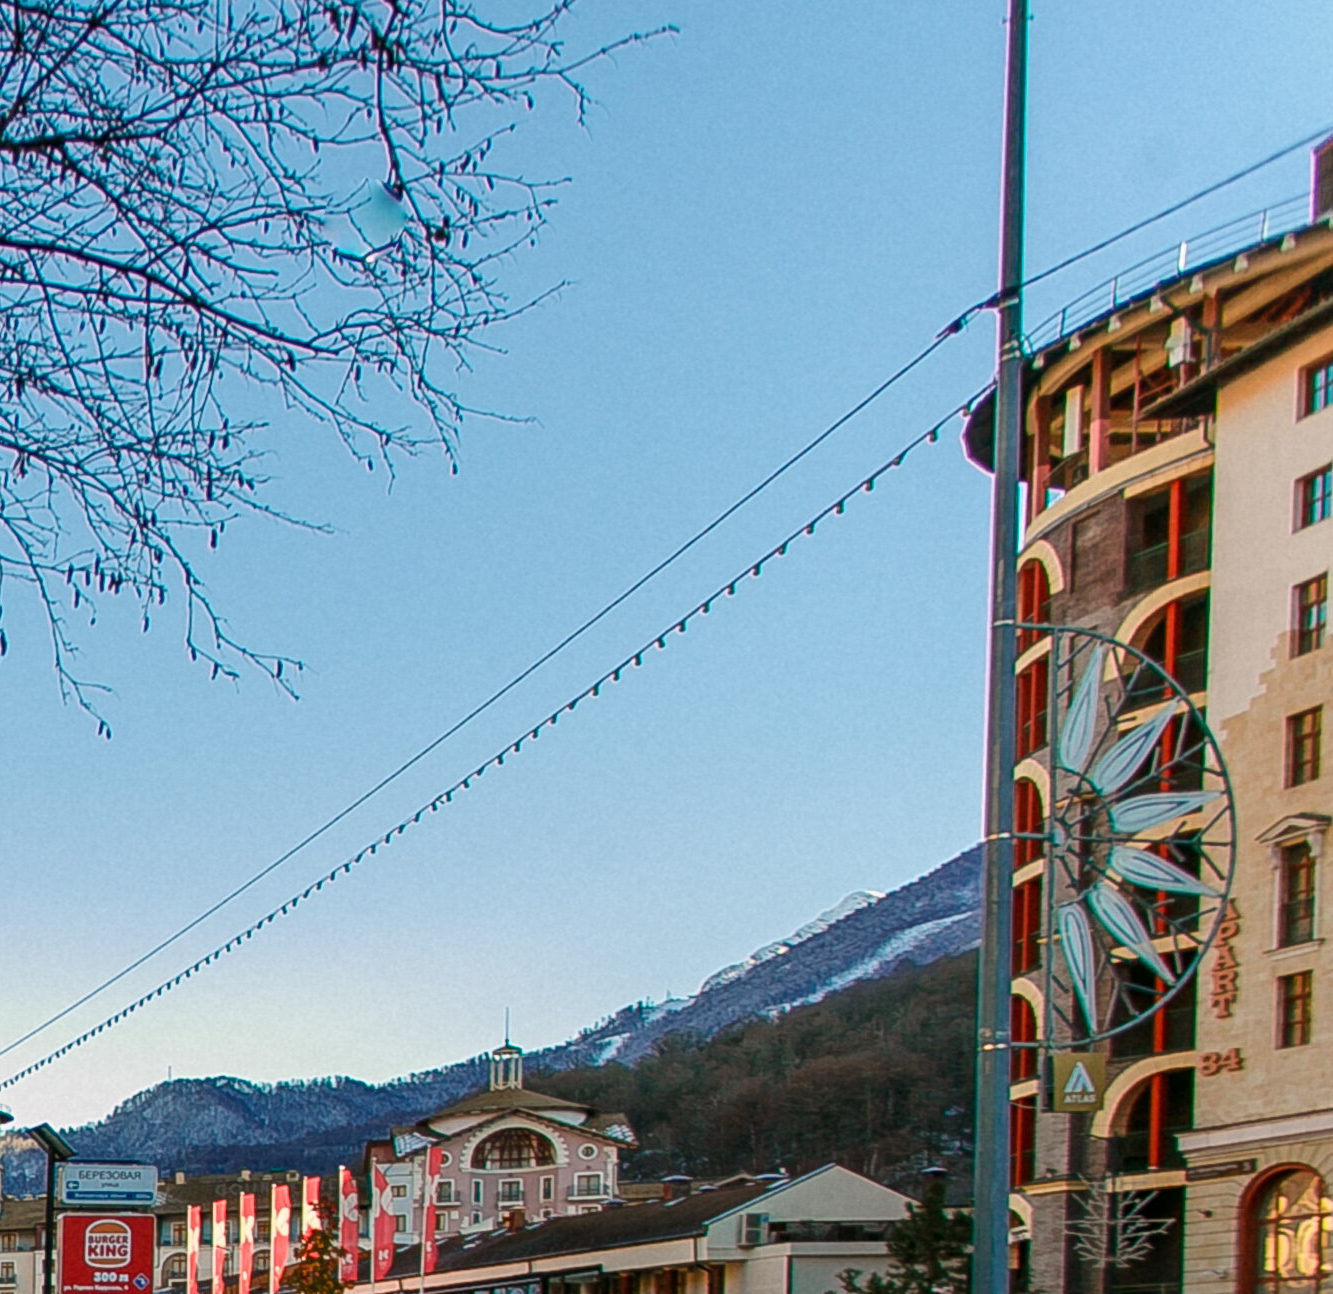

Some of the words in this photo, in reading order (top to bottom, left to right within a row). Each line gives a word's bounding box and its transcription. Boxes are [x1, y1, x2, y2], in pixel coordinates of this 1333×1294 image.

[1063, 1094, 1096, 1103] ATLAS
[78, 1170, 142, 1180] БЕРЕЗОВАЯ
[88, 1235, 128, 1244] BURGER
[88, 1245, 128, 1257] KING
